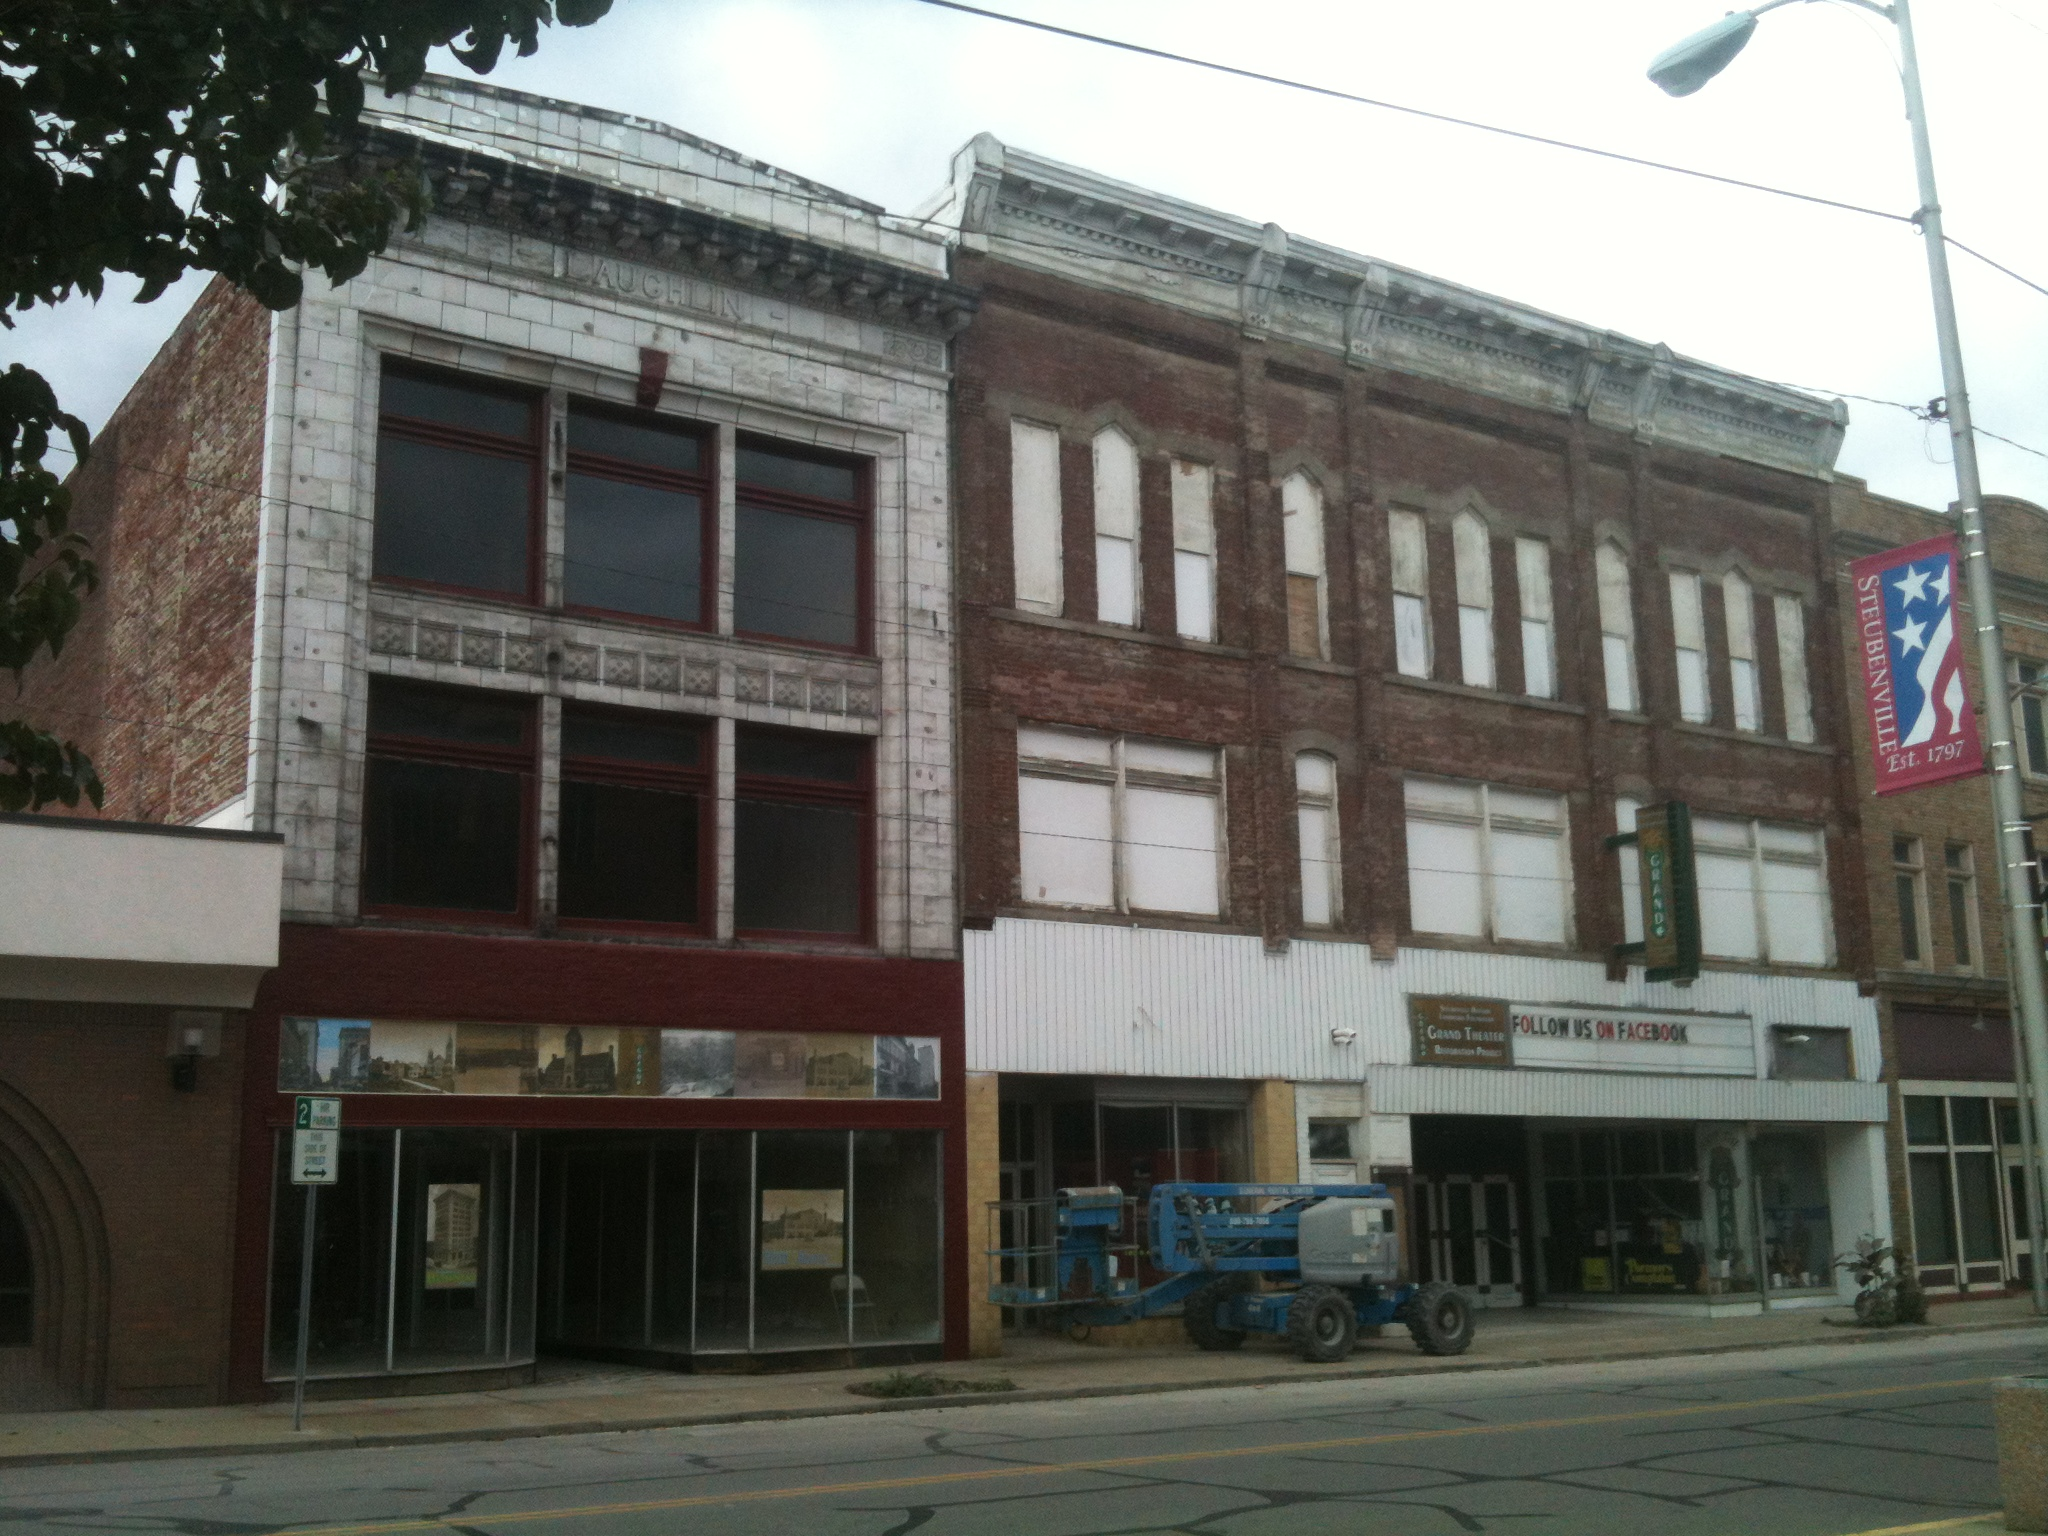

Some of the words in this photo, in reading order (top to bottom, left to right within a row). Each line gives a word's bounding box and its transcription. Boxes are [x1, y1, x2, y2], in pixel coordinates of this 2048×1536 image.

[1858, 574, 1898, 756] STEUBENVILLE
[1928, 739, 1965, 763] 1797
[1650, 853, 1665, 925] GRAND
[1512, 1015, 1570, 1038] FOLLOW
[1574, 1017, 1593, 1039] US
[1596, 1020, 1615, 1040] ON
[1618, 1020, 1689, 1044] FACEBOOK
[299, 1102, 309, 1125] 2
